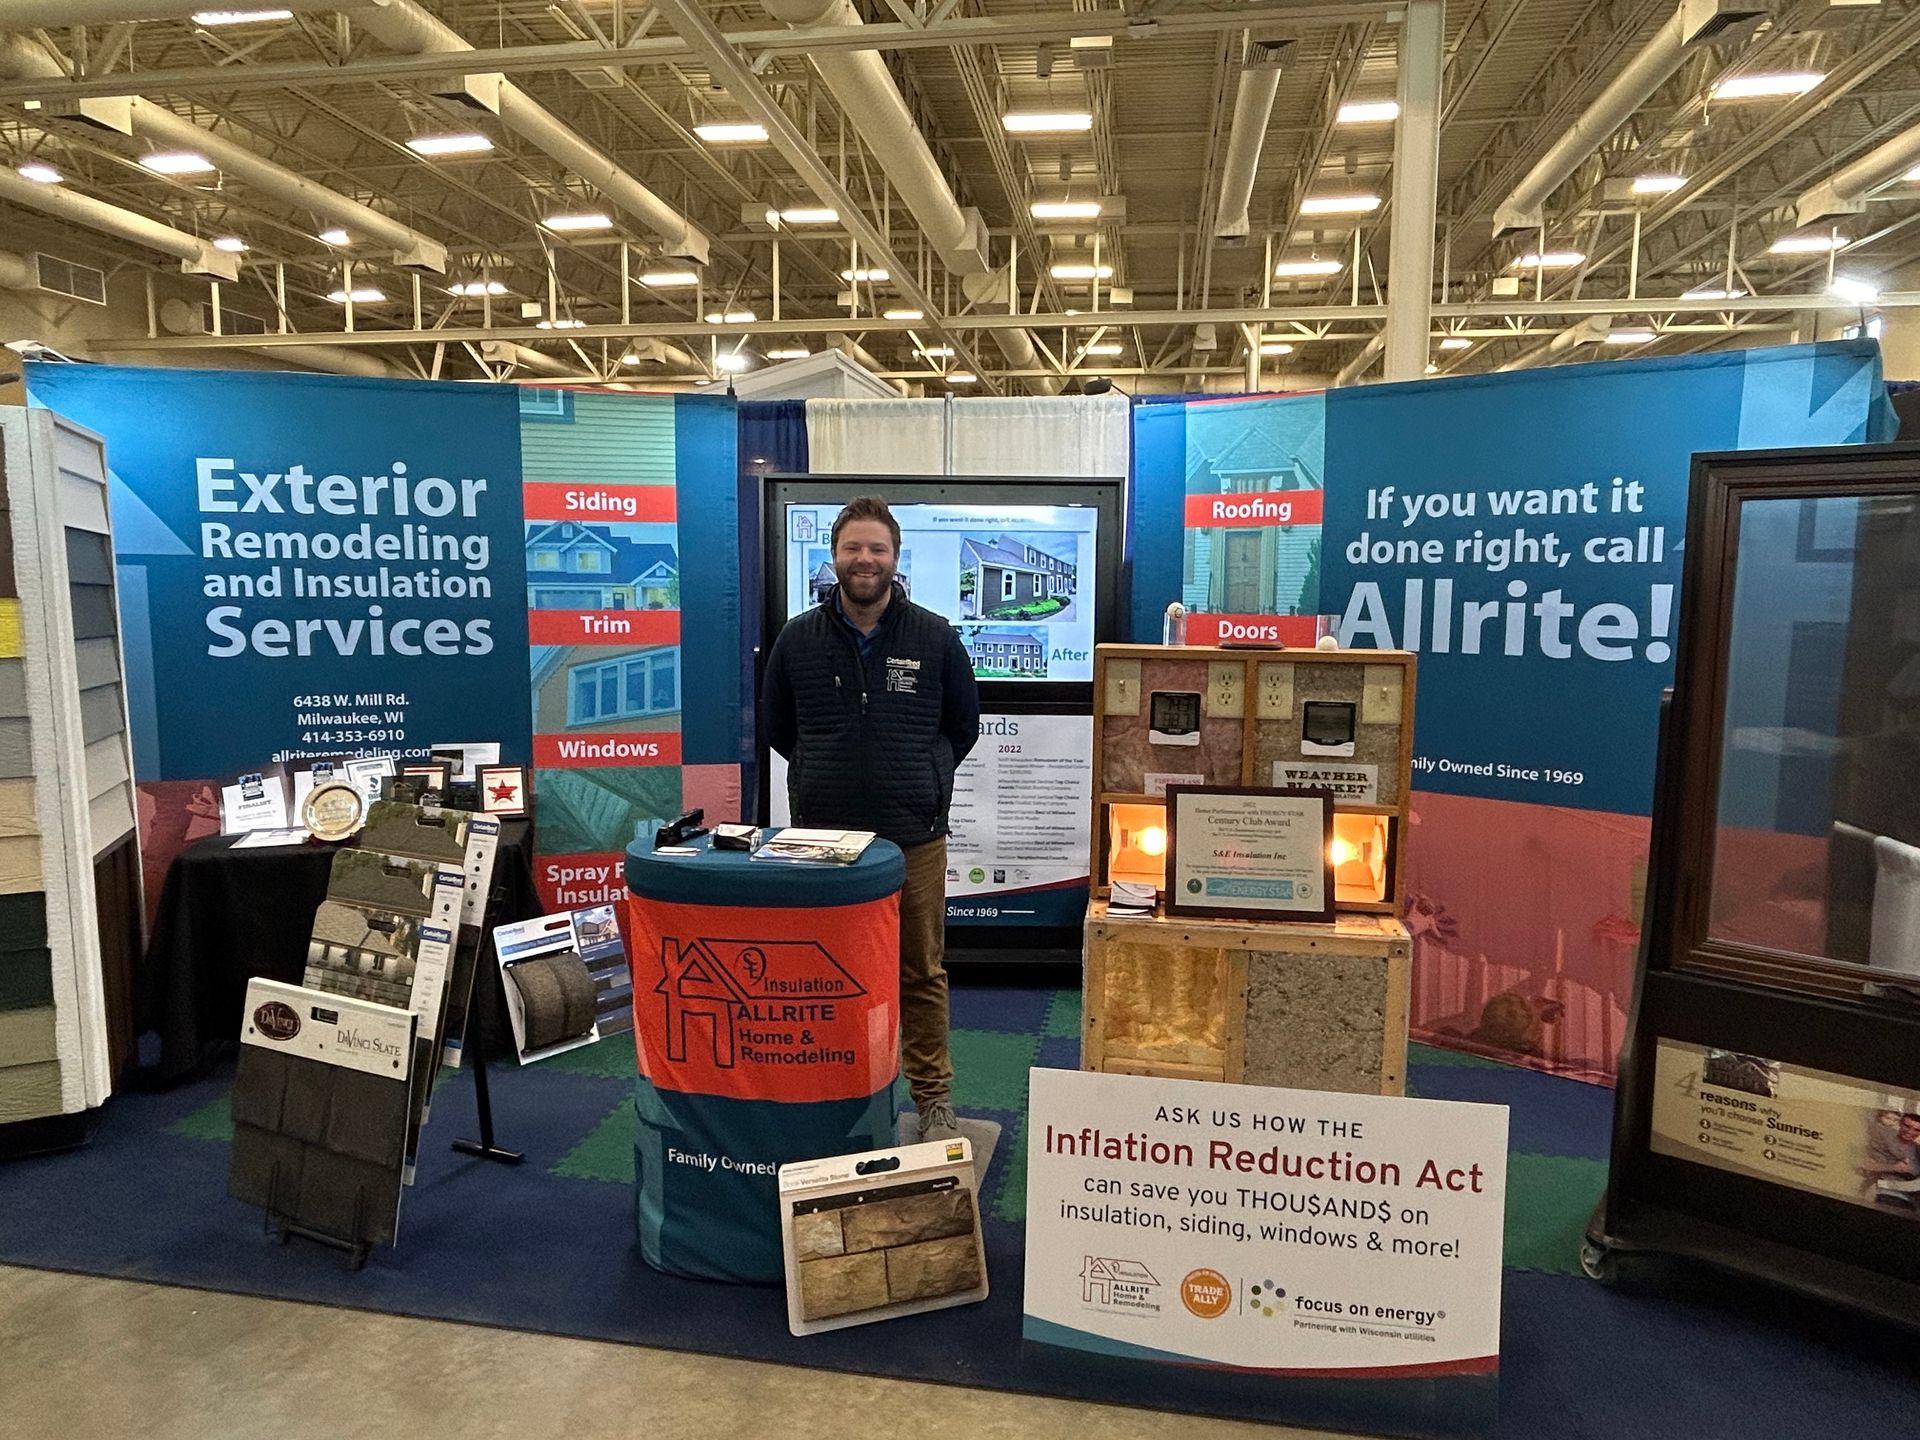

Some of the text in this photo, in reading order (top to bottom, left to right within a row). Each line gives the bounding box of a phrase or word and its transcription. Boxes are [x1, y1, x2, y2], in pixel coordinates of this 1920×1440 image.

[196, 457, 487, 517] Exterior
[564, 491, 637, 517] Siding
[1212, 498, 1292, 522] Roofing
[1367, 477, 1645, 528] If you want it
[200, 522, 490, 571] Remodeling
[1345, 526, 1665, 572] done right, call
[203, 566, 491, 598] and Insulation
[205, 604, 494, 658] Services
[580, 615, 631, 635] Trim
[1218, 620, 1278, 640] Doors
[1339, 578, 1674, 664] Allrite!
[1052, 648, 1089, 662] After
[293, 693, 410, 707] 6438 W. Mill Rd.
[298, 711, 404, 726] Milwaukee, WI
[978, 717, 1019, 736] ards
[302, 729, 405, 743] 414-353-6910
[557, 739, 659, 759] Windows
[998, 745, 1022, 753] 2022
[1285, 770, 1368, 782] WEATHER
[1438, 758, 1493, 777] Owned
[1497, 764, 1539, 781] Since
[1543, 769, 1584, 785] 1969
[1208, 816, 1292, 827] Century Club Award
[1212, 849, 1288, 860] S&E Insulation Inc
[546, 864, 610, 886] Spray
[556, 885, 629, 904] Insulat
[946, 906, 999, 919] Since 1969
[764, 977, 844, 993] Insulation
[736, 1004, 836, 1022] ALLRITE
[739, 1028, 816, 1045] Home &
[740, 1046, 856, 1065] Remodeling
[1700, 1091, 1757, 1112] reasons
[1759, 1107, 1781, 1119] why
[1155, 1106, 1364, 1139] ASK US HOW THE
[1727, 1111, 1764, 1126] choose
[1766, 1117, 1824, 1141] Sunrise:
[668, 1148, 718, 1173] Family
[721, 1156, 776, 1176] Owned
[1046, 1124, 1484, 1193] Inflation Reduction Act
[1084, 1177, 1429, 1226] can save you THOU$AND$ on
[1060, 1199, 1460, 1259] insulation, siding, windows & more!
[1113, 1291, 1145, 1301] Home &
[1114, 1283, 1150, 1294] ALLRITE
[1189, 1284, 1224, 1296] TRADE
[1113, 1299, 1161, 1312] Remodeling
[1193, 1294, 1219, 1305] ALLY
[1295, 1296, 1343, 1314] focus
[1349, 1303, 1369, 1317] on
[1294, 1319, 1436, 1343] Partnering with Wisconsin utilities
